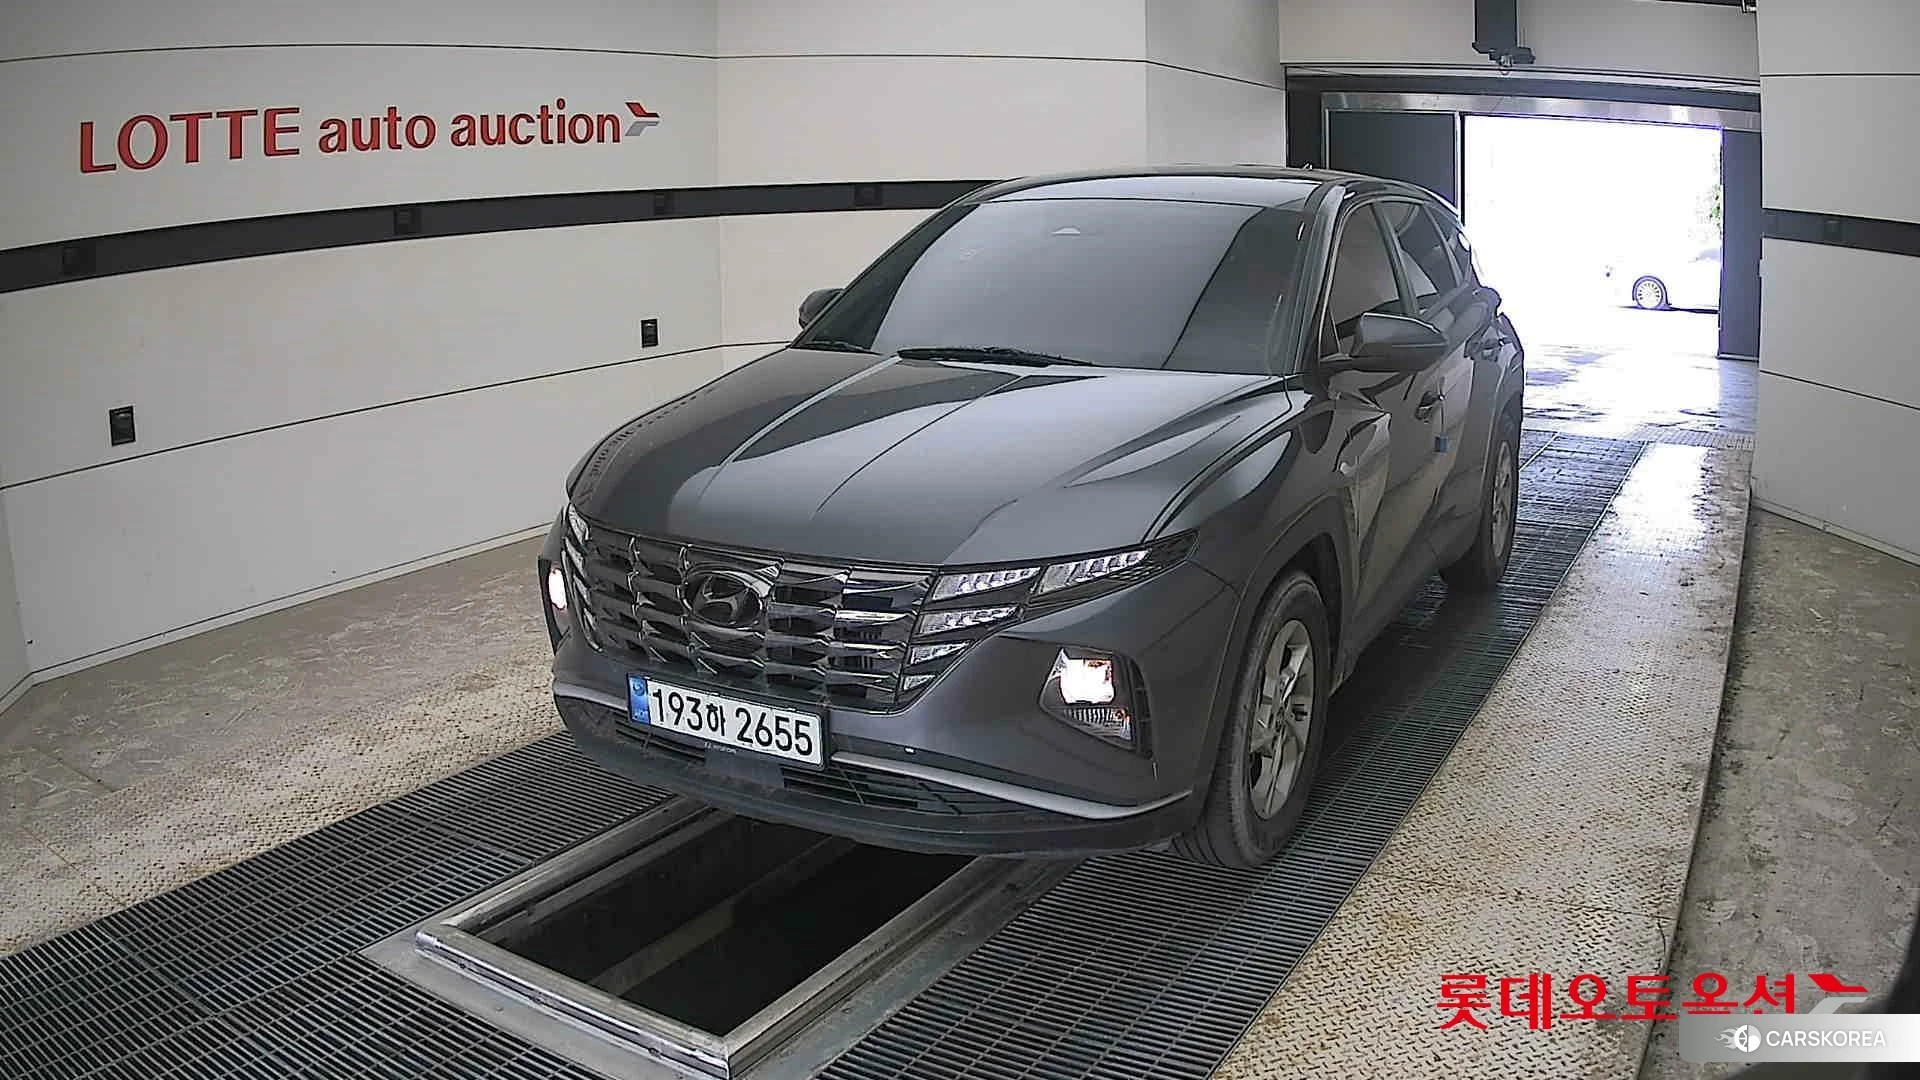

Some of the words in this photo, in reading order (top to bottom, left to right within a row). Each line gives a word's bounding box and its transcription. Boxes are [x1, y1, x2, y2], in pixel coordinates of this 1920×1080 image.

[79, 106, 300, 174] LOTTE
[318, 106, 437, 153] auto
[450, 99, 622, 147] auction
[652, 688, 726, 737] 193하
[735, 706, 813, 756] 2655
